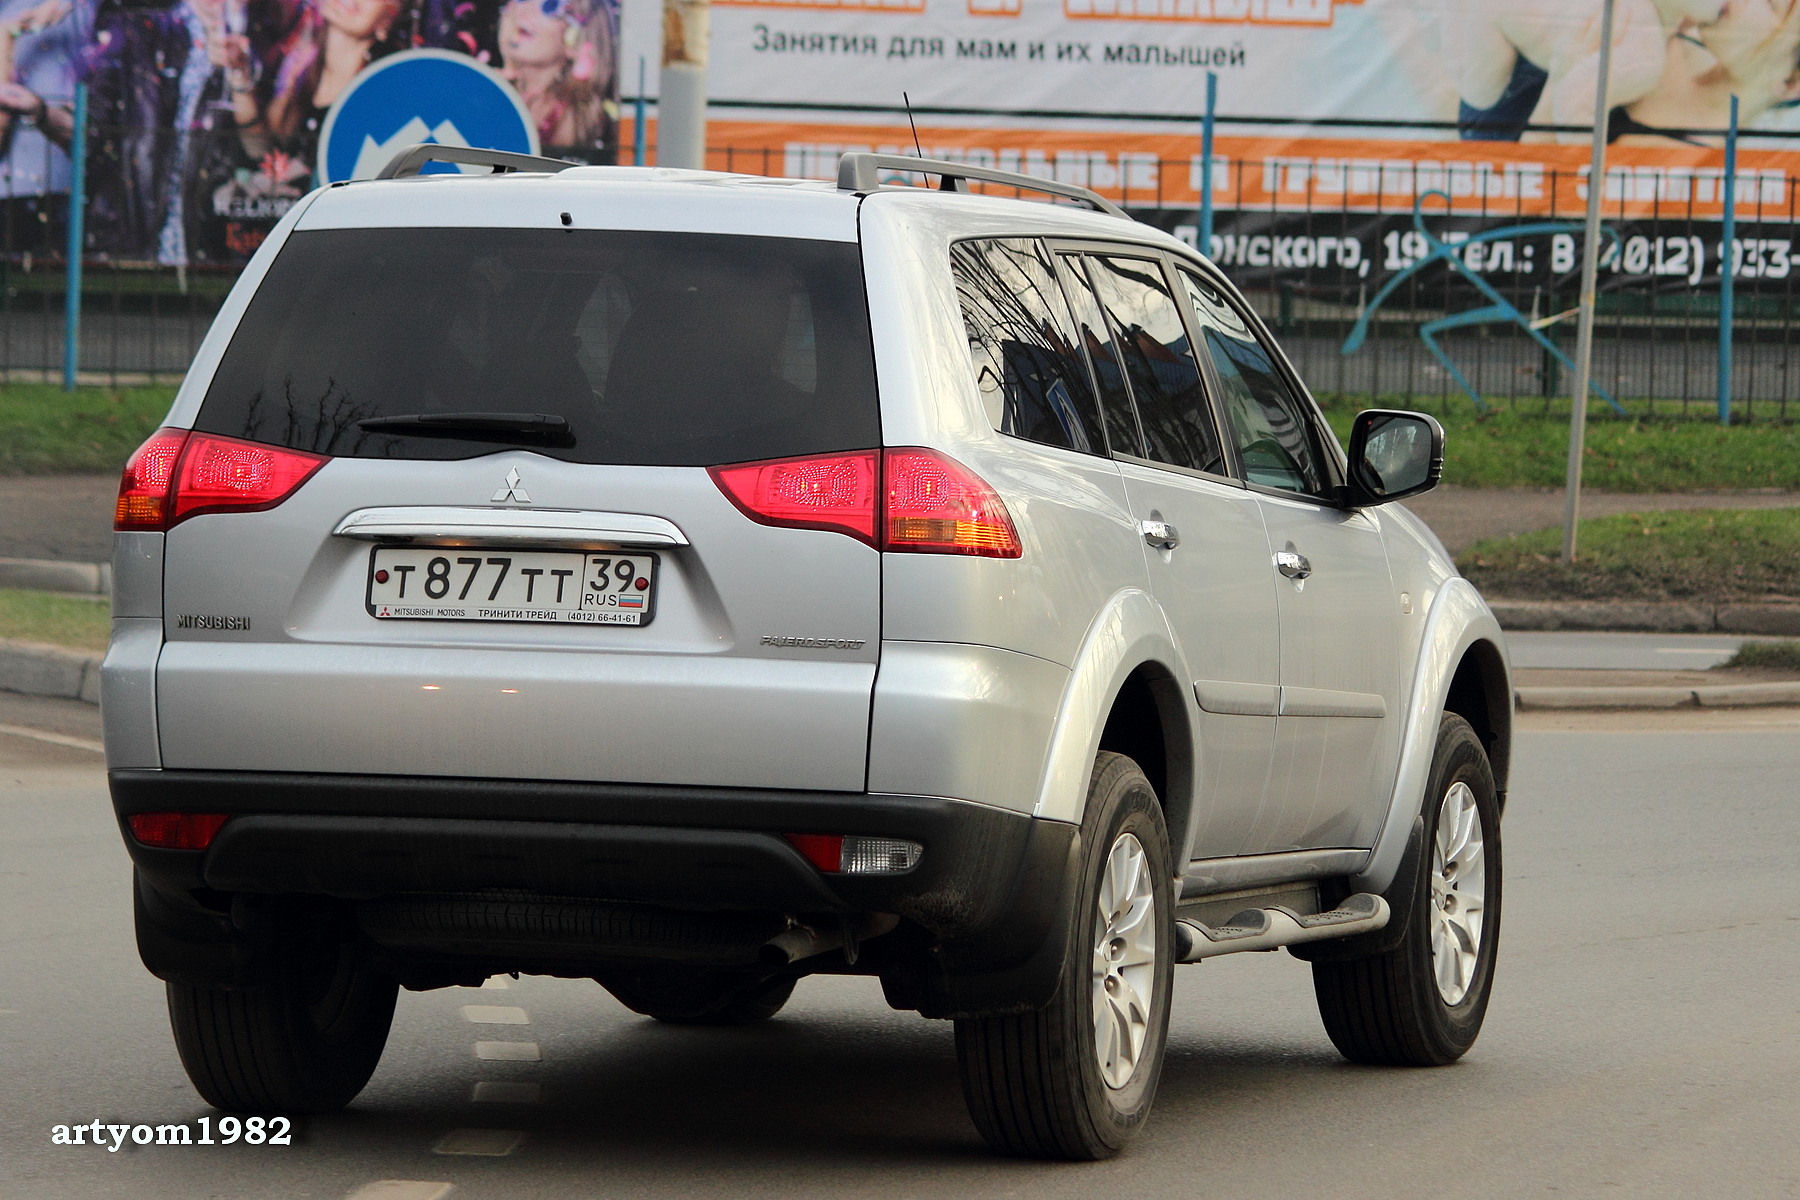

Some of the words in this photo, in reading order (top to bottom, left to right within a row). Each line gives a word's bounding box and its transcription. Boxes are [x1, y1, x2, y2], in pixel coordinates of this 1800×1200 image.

[753, 24, 878, 54] Занятия
[886, 36, 945, 60] для
[955, 39, 1017, 60] мам
[1028, 42, 1045, 61] и
[1056, 42, 1091, 62] их
[1103, 42, 1246, 67] малышей
[1383, 230, 1429, 271] 19
[589, 558, 636, 593] 39
[584, 593, 618, 607] RUS
[177, 613, 251, 631] MITSUBISHI
[394, 607, 434, 617] MITSUBISHI
[437, 608, 466, 618] MOTORS
[478, 609, 523, 619] ТРИНИТИ
[525, 610, 557, 621] ТРЕЙД
[567, 611, 596, 622] (4012)
[597, 613, 637, 623] 66-41-61
